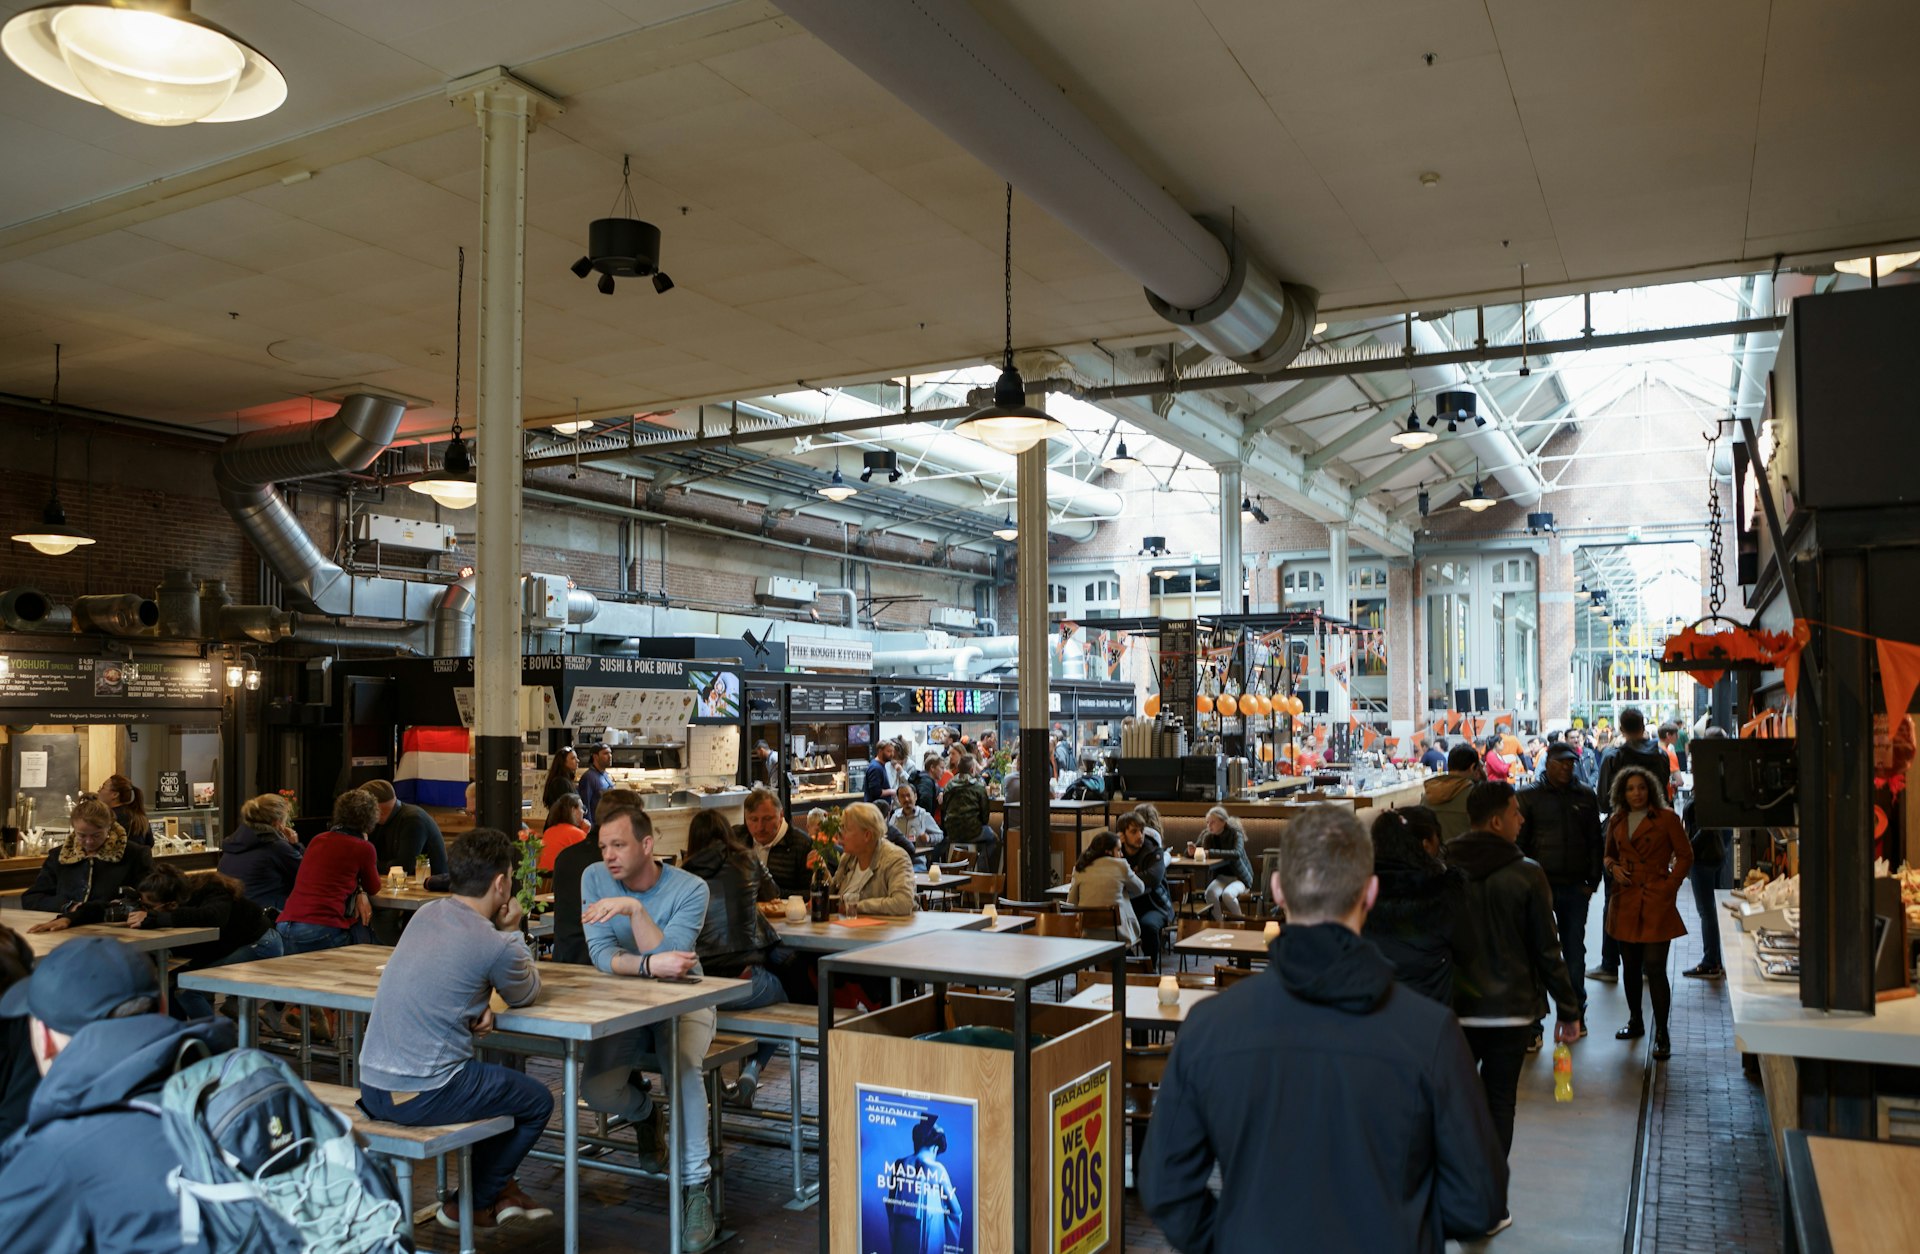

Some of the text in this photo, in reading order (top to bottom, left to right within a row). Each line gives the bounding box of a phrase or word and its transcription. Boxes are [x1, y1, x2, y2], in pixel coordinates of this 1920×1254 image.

[564, 655, 586, 663] MENEER
[791, 645, 872, 661] THE ROUGH KITCHEN
[10, 659, 51, 670] YOGHURT
[529, 656, 562, 670] BOWLS
[565, 662, 585, 670] TEMAKI
[600, 658, 683, 675] SUSHI & POKE BOWLS
[915, 687, 981, 713] SHIRKHAN
[1054, 1072, 1107, 1110] PARADISO
[868, 1104, 919, 1118] NATIONALE
[868, 1113, 897, 1127] OPERA
[1062, 1124, 1083, 1156] WE
[884, 1160, 950, 1184] MADAMA
[877, 1174, 957, 1201] BUTTERFLY
